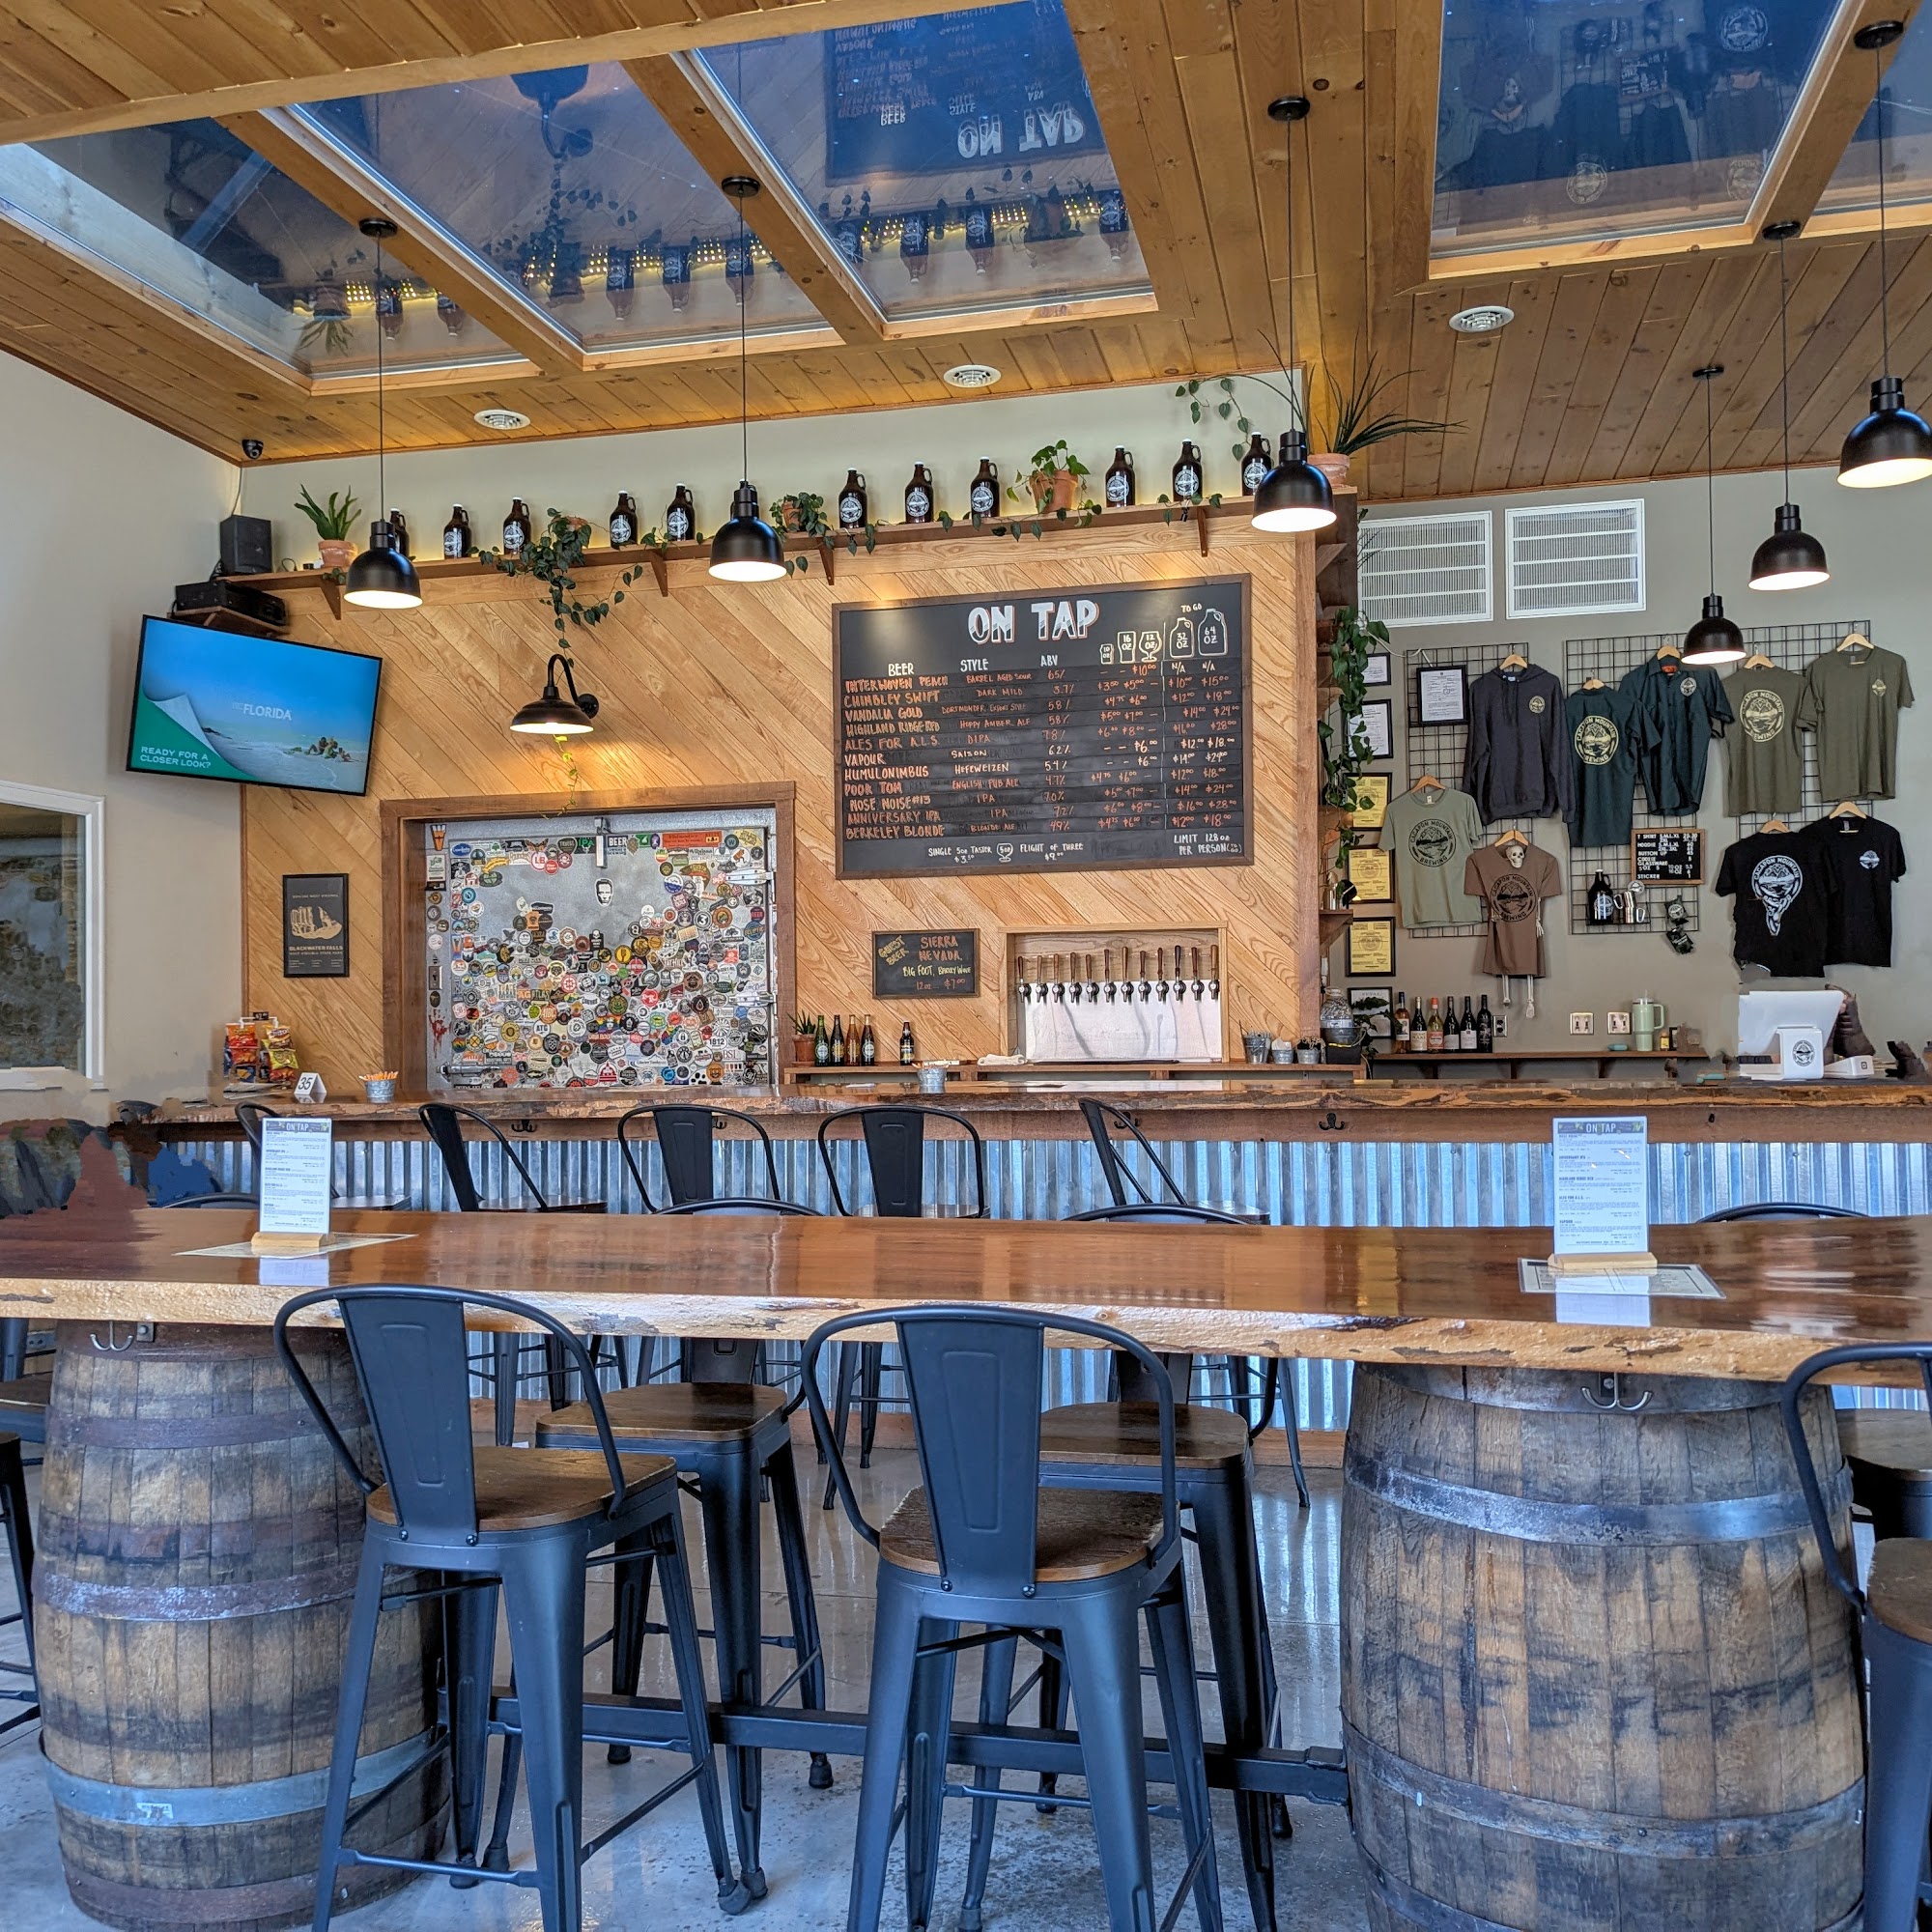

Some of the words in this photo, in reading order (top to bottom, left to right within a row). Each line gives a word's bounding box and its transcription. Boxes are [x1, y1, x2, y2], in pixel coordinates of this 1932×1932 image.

[968, 605, 1015, 645] ON
[1031, 599, 1100, 641] TAP
[1204, 626, 1216, 635] 64
[960, 659, 989, 672] STYLE
[1040, 655, 1059, 667] ABV
[1171, 662, 1186, 675] N/A
[1202, 660, 1216, 672] N/A
[888, 663, 914, 676] BEER
[905, 690, 941, 705] SWIFT
[976, 689, 997, 697] DARK
[1002, 688, 1023, 696] MILD
[242, 703, 293, 721] FLORIDA
[897, 706, 923, 720] GOLD
[844, 737, 873, 752] ALES
[878, 736, 903, 750] FOR
[967, 734, 991, 744] DIPA
[140, 754, 179, 766] CLOSER
[180, 757, 212, 769] LOOK?
[141, 747, 176, 757] READY
[179, 749, 198, 759] FOR
[200, 752, 209, 761] A
[844, 753, 887, 767] VAPOUR
[951, 750, 987, 758] SAISON
[844, 766, 929, 781] HUMULONIMBUS
[954, 762, 1009, 775] HEFEWEIZEN
[844, 782, 873, 797] POOR
[879, 781, 903, 794] TOM
[952, 780, 983, 789] ENGLISH
[987, 778, 1004, 788] PUB
[1006, 778, 1019, 787] ALE
[850, 797, 876, 811] NOSE
[977, 794, 996, 804] IPA
[847, 810, 922, 825] ANNIVERSARY
[925, 810, 942, 822] IPA
[990, 809, 1009, 817] IPA
[845, 826, 900, 840] BERKELEY
[904, 824, 945, 838] BLONDE
[1174, 834, 1199, 844] LIMIT
[1410, 821, 1430, 843] CACAPON
[1431, 820, 1455, 840] MOUNTAIN
[609, 838, 627, 846] BEER
[1020, 843, 1044, 853] FLIGHT
[1063, 842, 1084, 851] THREE
[928, 846, 952, 857] SINGLE
[1179, 845, 1193, 855] PER
[1419, 856, 1448, 866] BREWING
[1776, 856, 1800, 879] MOUNTAIN
[1512, 874, 1534, 896] MOUNTAIN
[698, 914, 707, 925] 3
[878, 935, 905, 958] GUEST
[921, 935, 958, 950] SIERRA
[886, 948, 909, 966] BEER
[902, 966, 916, 977] BIG
[298, 1077, 313, 1091] 35
[286, 1122, 297, 1131] ON
[298, 1122, 309, 1131] TAP
[1585, 1123, 1598, 1133] ON
[1601, 1122, 1616, 1133] TAP
